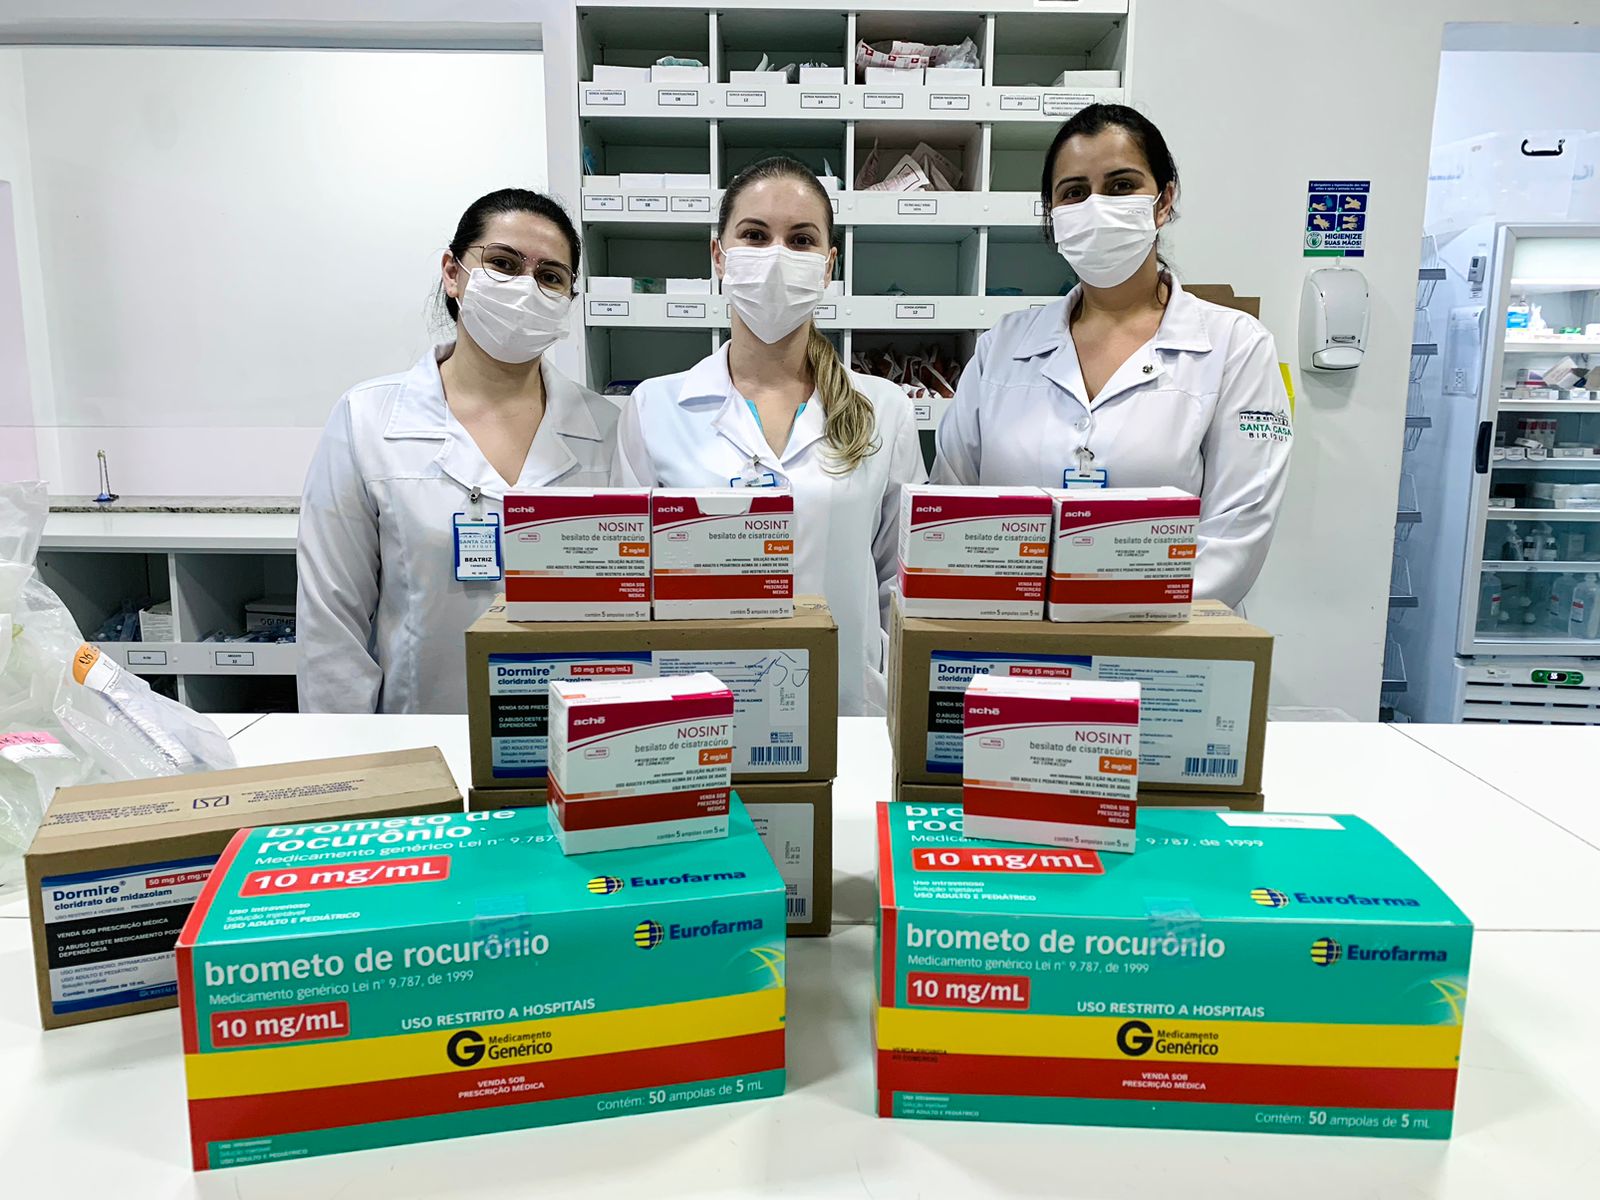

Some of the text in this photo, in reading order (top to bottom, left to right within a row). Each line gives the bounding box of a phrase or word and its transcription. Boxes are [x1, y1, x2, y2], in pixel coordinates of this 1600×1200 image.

[1239, 423, 1293, 437] SANTA CASA
[598, 522, 645, 532] NOSINT
[744, 520, 789, 530] NOSINT
[1001, 522, 1047, 532] NOSINT
[1150, 524, 1195, 535] NOSINT
[561, 533, 590, 541] besilato
[592, 533, 601, 541] de
[708, 532, 737, 540] besilato
[738, 532, 747, 540] de
[965, 533, 993, 541] besilato
[994, 533, 1003, 541] de
[1143, 536, 1152, 544] de
[583, 667, 595, 675] mg
[596, 666, 603, 674] (5
[604, 665, 631, 674] mg/mL)
[538, 677, 548, 685] de
[677, 725, 728, 740] NOSINT
[1075, 731, 1132, 745] NOSINT
[635, 738, 729, 753] besilato de cisatracúrio
[1029, 741, 1133, 757] besilato de cisatracúrio
[702, 752, 708, 761] 2
[1103, 760, 1110, 769] 2
[265, 808, 516, 839] brometo de
[257, 823, 472, 855] rocurônio
[1200, 837, 1220, 847] de
[1226, 838, 1264, 848] 1999
[254, 849, 376, 866] Medicamento
[379, 841, 454, 857] genérico
[459, 838, 482, 849] Lei
[920, 851, 1094, 870] 10 mg/mL
[149, 878, 160, 886] 50
[161, 876, 175, 885] mg
[177, 875, 185, 883] (5
[254, 860, 441, 889] 10 mg/mL
[631, 869, 747, 889] Eurofarma
[54, 888, 173, 911] cloridrato de midazolam
[935, 892, 971, 900] ADULTO
[981, 892, 1037, 901] PEDIÁTRICO
[1293, 891, 1421, 908] Eurofarma
[223, 922, 246, 931] USO
[247, 918, 288, 928] ADULTO
[300, 911, 361, 923] PEDIÁTRICO
[669, 916, 764, 940] Eurofarma
[56, 930, 81, 939] VENDA
[82, 928, 96, 936] SOB
[98, 921, 142, 933] PRESCRIÇÃO
[65, 943, 90, 951] ABUSO
[91, 939, 113, 948] DESTE
[114, 931, 163, 944] MEDICAMENTO
[906, 923, 1226, 959] brometo de rocurônio
[58, 946, 108, 959] DEPENDÊNCIA
[204, 952, 345, 986] brometo
[354, 946, 393, 974] de
[404, 930, 550, 969] rocurônio
[1347, 945, 1448, 963] Eurofarma
[907, 954, 983, 968] Medicamento
[985, 956, 1033, 972] genérico
[1035, 959, 1051, 970] Lei
[1105, 961, 1120, 973] de
[1123, 962, 1150, 974] 1999
[209, 987, 294, 1005] Medicamento
[297, 983, 349, 1001] genérico
[352, 981, 369, 993] Lei
[389, 974, 425, 991] 9.787,
[427, 973, 443, 985] de
[447, 969, 474, 983] 1999
[912, 979, 1025, 1004] 10 mg/mL
[401, 998, 596, 1030] USO RESTRITO A HOSPITAIS
[1077, 1001, 1265, 1017] USO RESTRITO A HOSPITAIS
[217, 1010, 345, 1039] 10 mg/mL
[488, 1030, 552, 1045] Medicamento
[1157, 1030, 1219, 1040] Medicamento
[488, 1039, 553, 1060] Genérico
[1155, 1039, 1219, 1056] Genérico
[477, 1075, 525, 1088] VENDA SOB
[1122, 1079, 1206, 1090] PRESCRIÇÃO MÉDICA
[1141, 1072, 1188, 1081] VENDA SOB
[458, 1081, 545, 1099] PRESCRIÇÃO MÉDICA
[596, 1078, 764, 1113] Contém: 50 ampolas de 5 mL
[1255, 1110, 1431, 1129] Contém: 50 ampolas de 5 mL
